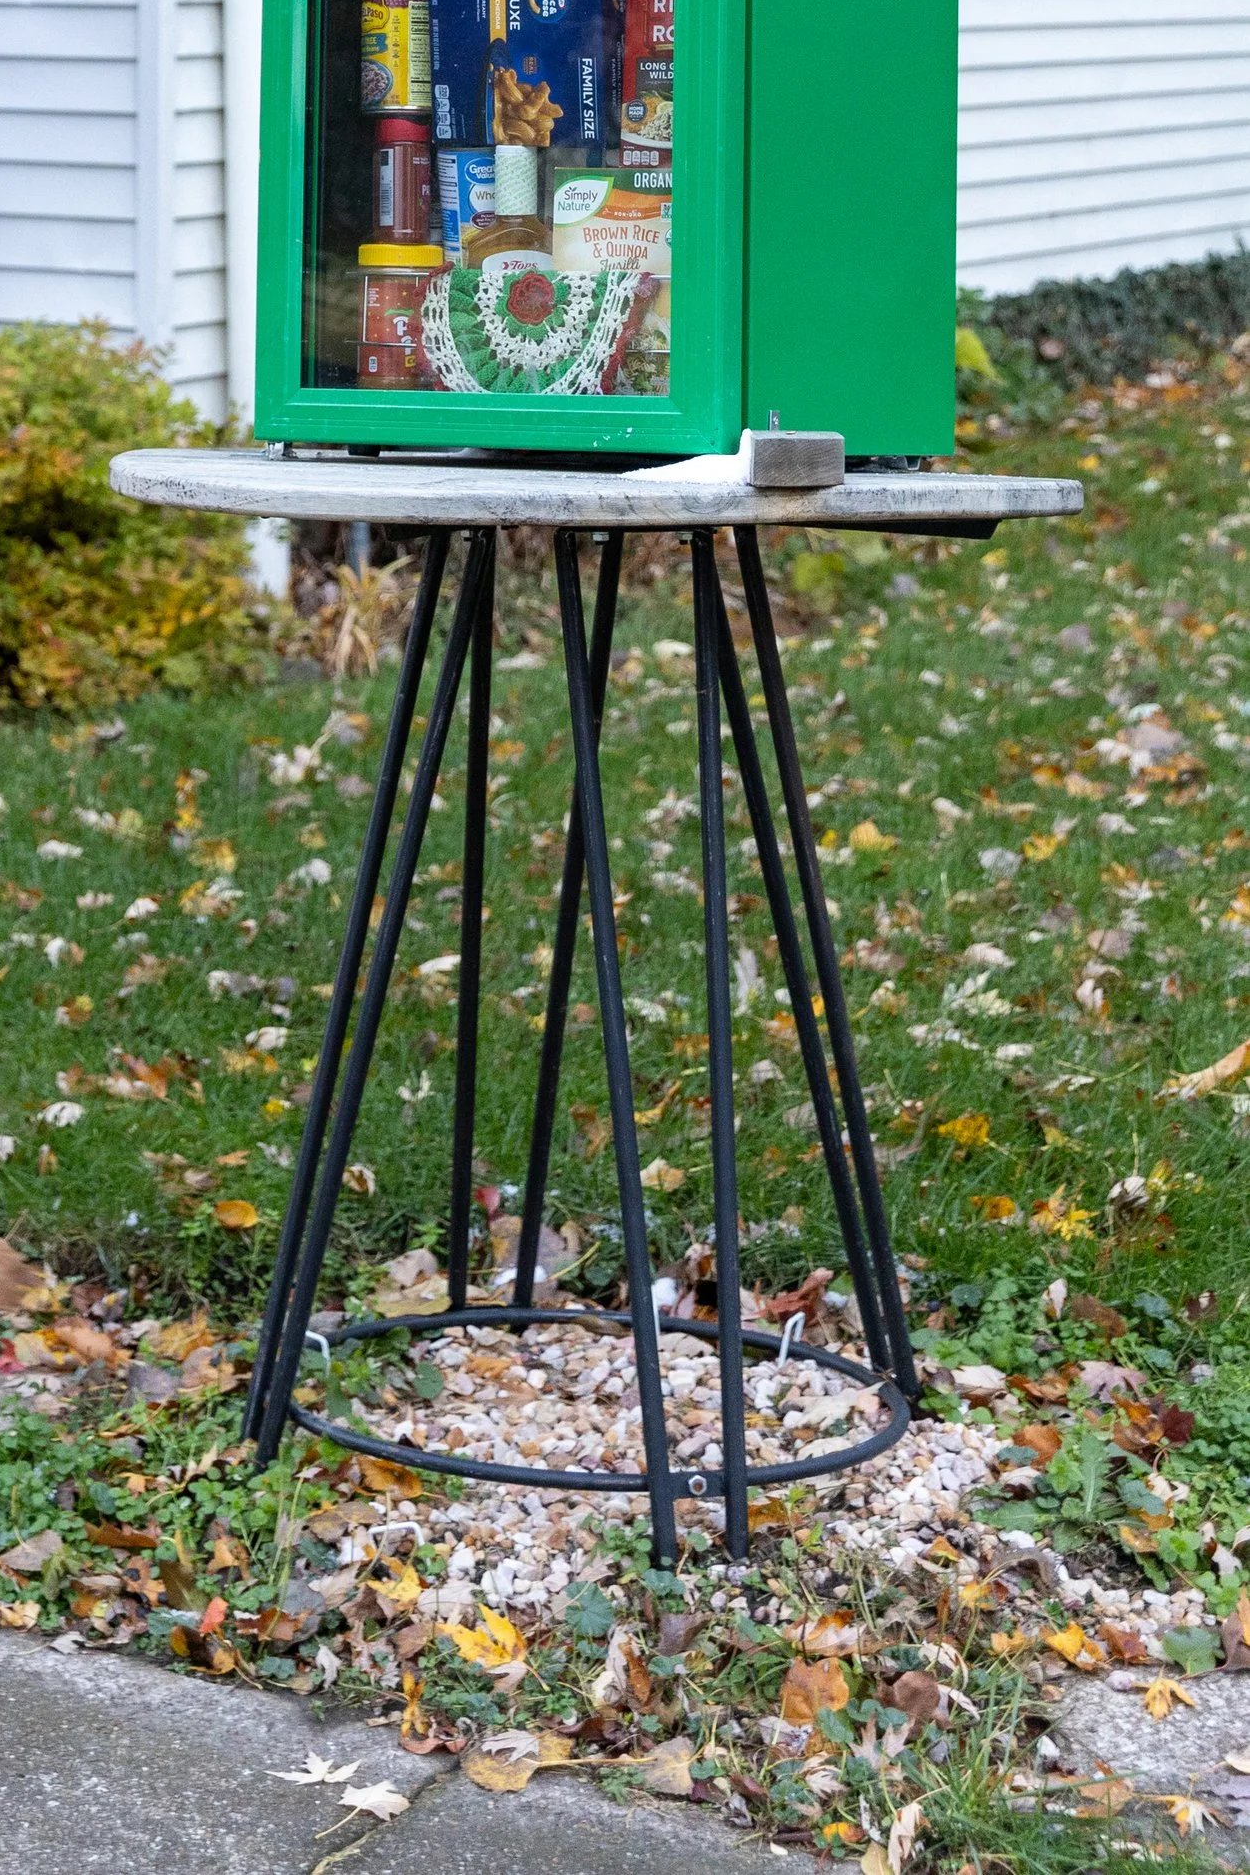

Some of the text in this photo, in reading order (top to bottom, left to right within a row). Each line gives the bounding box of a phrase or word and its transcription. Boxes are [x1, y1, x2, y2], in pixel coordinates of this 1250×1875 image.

[640, 62, 667, 71] LONG
[649, 71, 674, 80] WILD
[581, 57, 595, 139] FAMILY SIZE
[469, 164, 495, 174] Grea
[633, 172, 672, 189] ORGAN
[563, 188, 598, 204] Simply
[557, 200, 591, 211] Nature
[582, 224, 660, 244] BROWN RICE
[592, 241, 649, 260] & QUINOA
